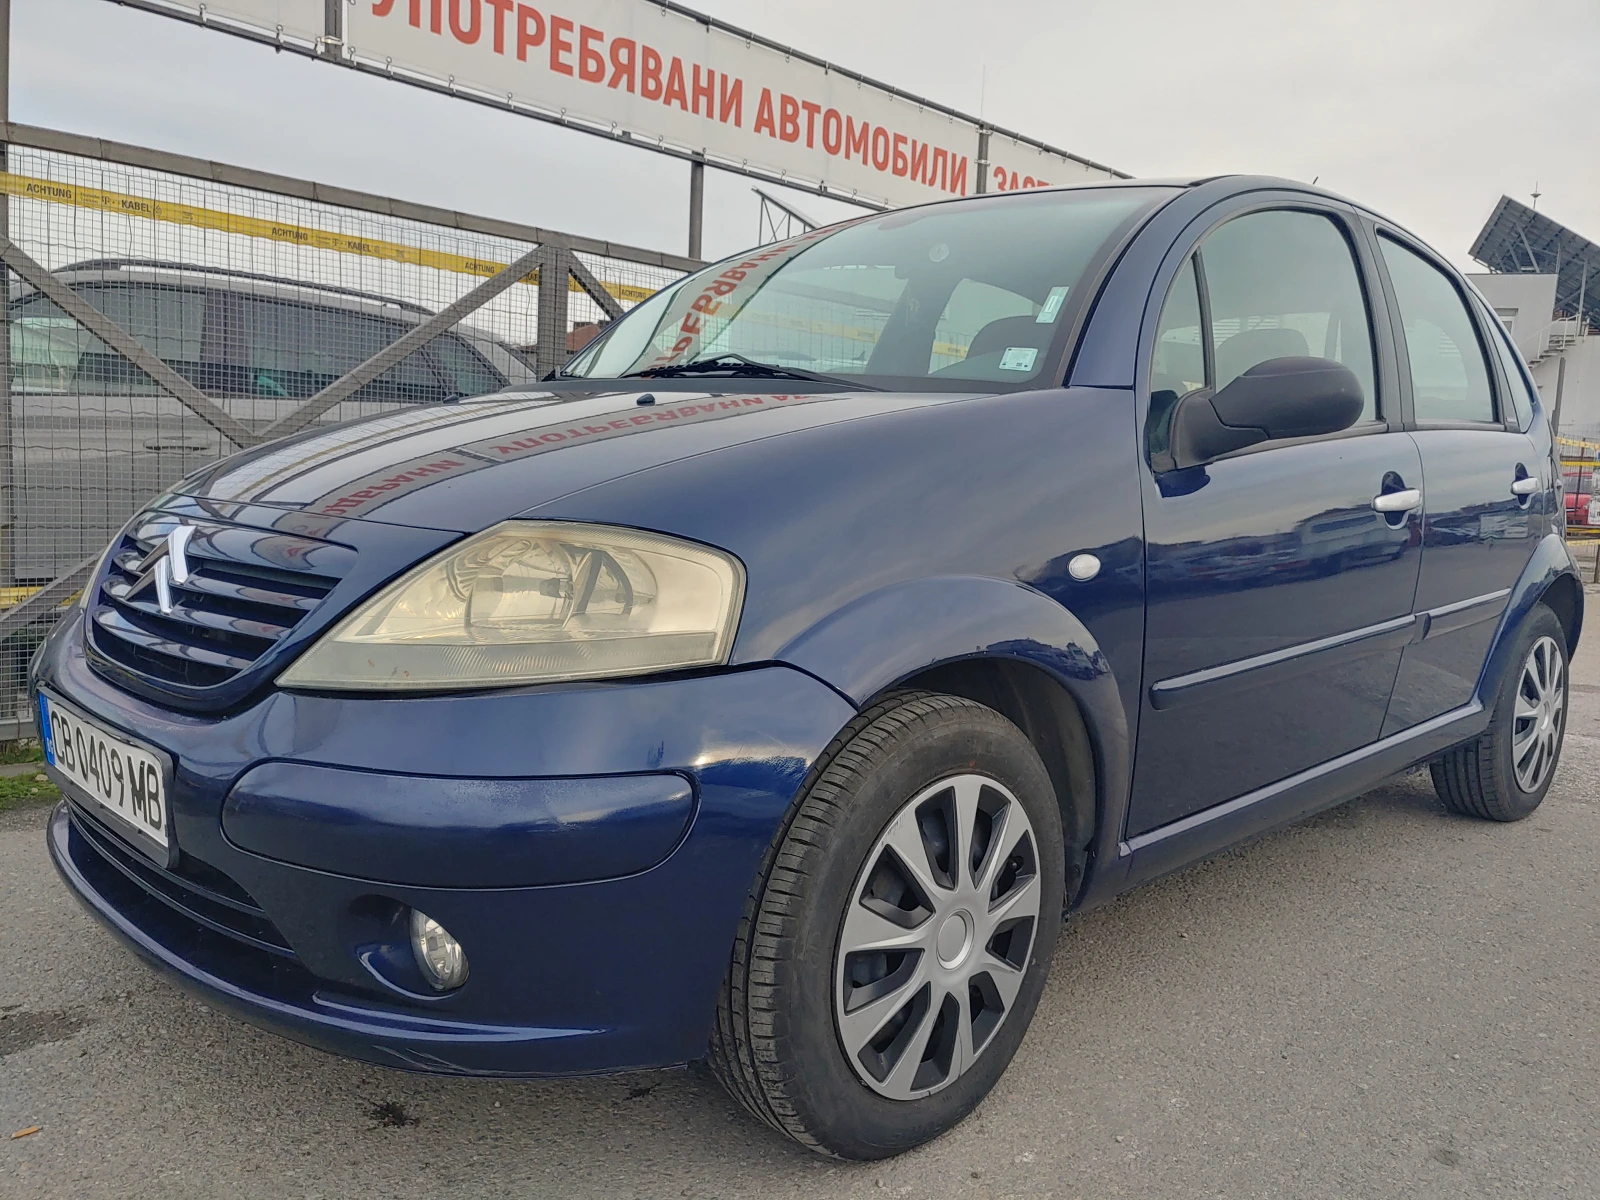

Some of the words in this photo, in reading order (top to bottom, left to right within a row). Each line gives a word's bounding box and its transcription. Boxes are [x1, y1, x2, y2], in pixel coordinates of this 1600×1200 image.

[372, 0, 743, 128] ОТРЕБЯВАНИ
[753, 87, 968, 196] АВТОМОБИЛИ
[26, 183, 72, 199] ACHTUNG
[121, 199, 151, 213] KABEL
[271, 227, 308, 241] ACHTUNG
[347, 240, 371, 253] KABEL
[464, 261, 495, 274] ACHTUNG
[621, 288, 647, 299] ACHTUNG
